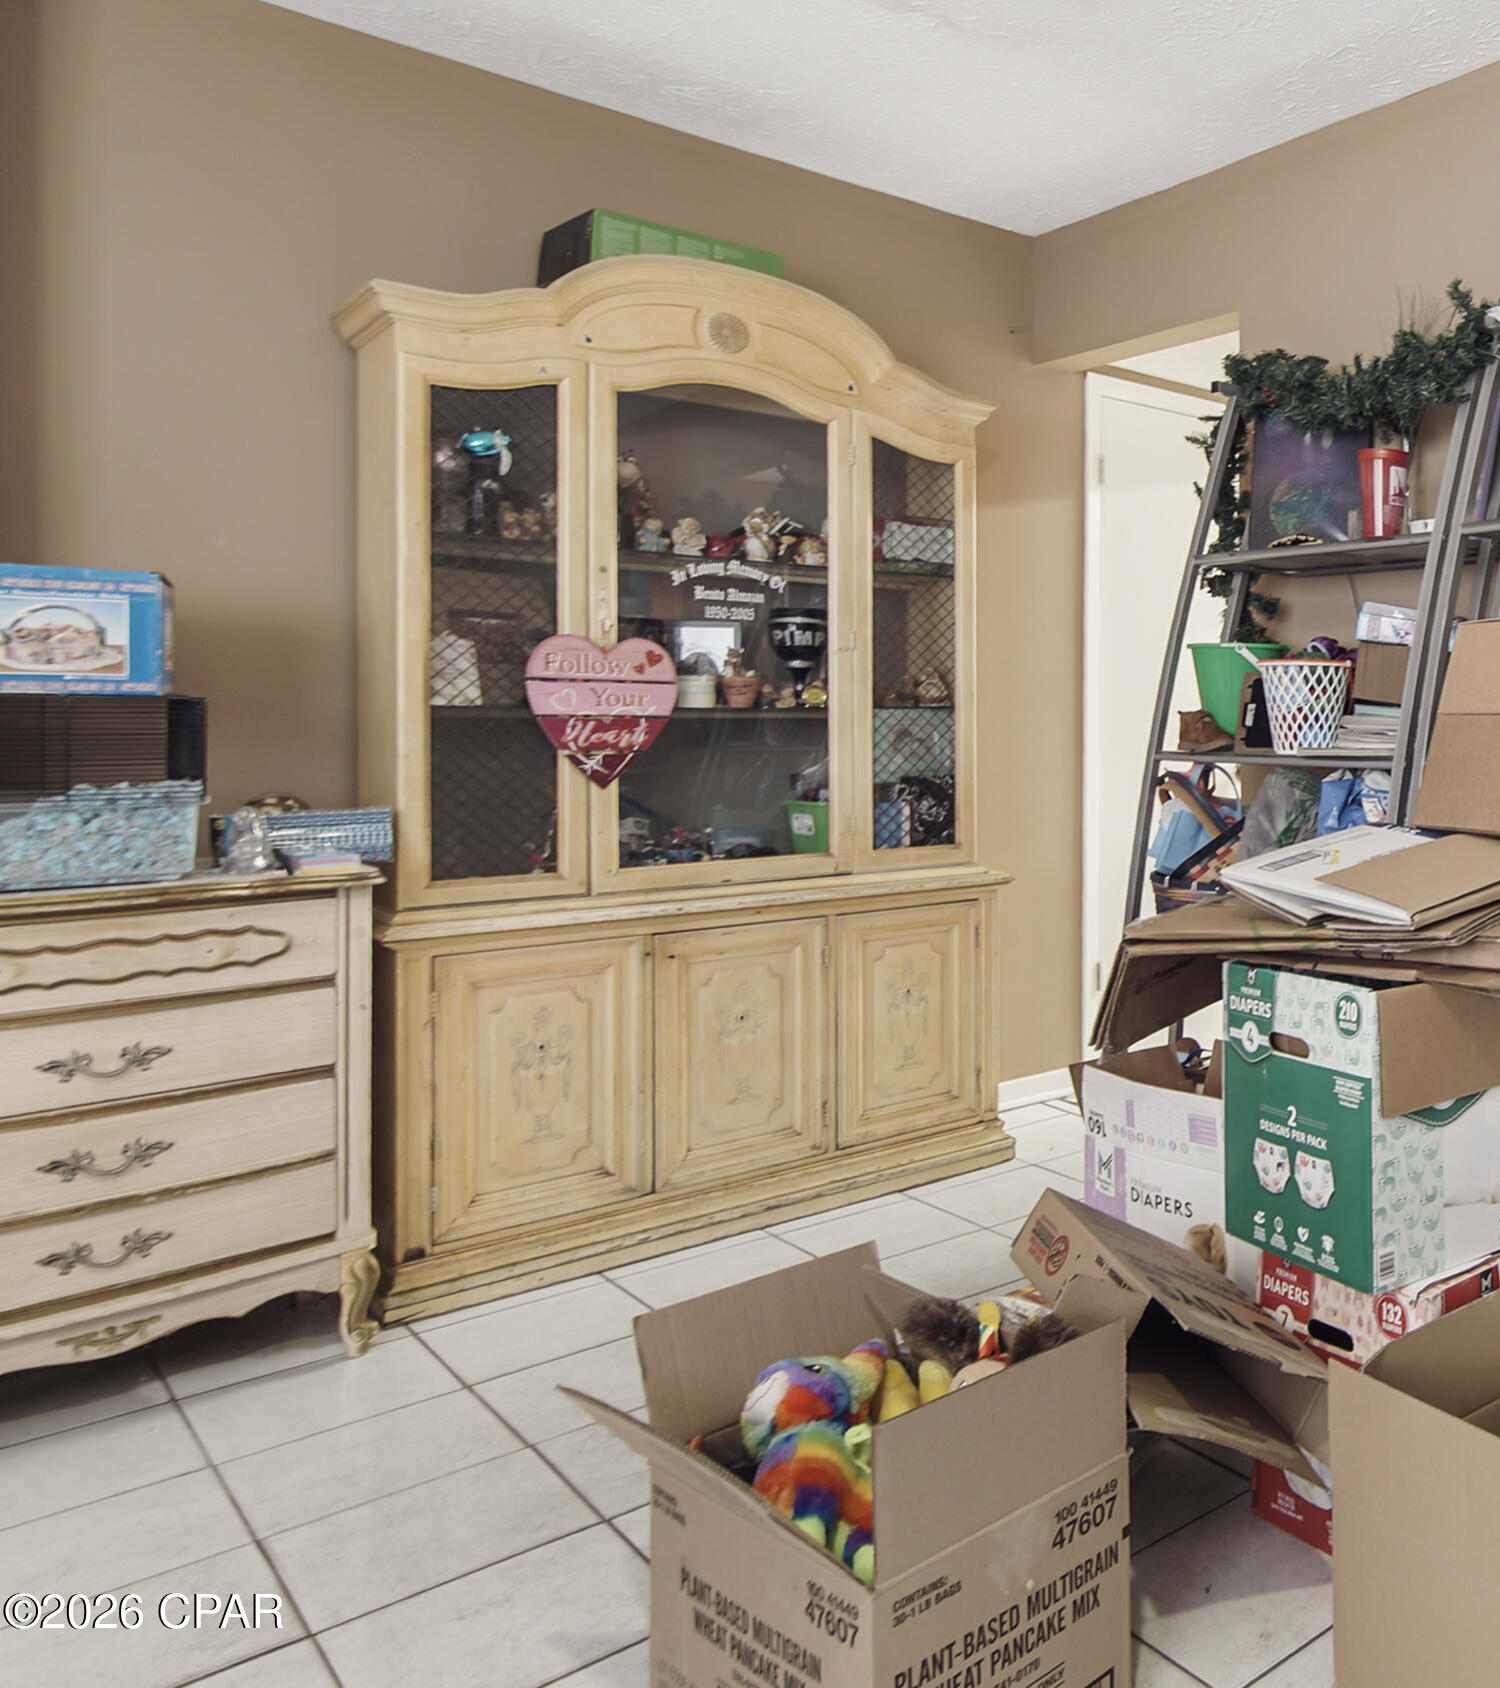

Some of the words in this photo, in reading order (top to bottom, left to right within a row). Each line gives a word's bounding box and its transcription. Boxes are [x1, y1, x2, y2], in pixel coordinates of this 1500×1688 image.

[669, 569, 687, 586] In
[686, 561, 725, 579] Loving
[726, 559, 769, 585] Memory
[542, 652, 632, 678] Follow
[589, 685, 649, 708] Your
[559, 717, 650, 749] Heart
[1229, 995, 1272, 1019] DIAPERS
[1339, 1000, 1359, 1022] 210
[1246, 1027, 1254, 1046] 4
[1287, 1105, 1297, 1127] 2
[1259, 1118, 1291, 1139] DESIGNS
[1291, 1129, 1306, 1144] PER
[1307, 1133, 1328, 1151] PACK
[1130, 1186, 1193, 1218] DIAPERS
[1263, 1274, 1310, 1307] DIAPERS
[1281, 1310, 1289, 1327] 7
[1381, 1301, 1402, 1325] 132
[1054, 1501, 1079, 1524] 100
[1080, 1478, 1118, 1513] 41449
[1051, 1494, 1118, 1550] 47607
[892, 1575, 949, 1614] CONTAINS:
[918, 1598, 932, 1616] LB
[934, 1580, 962, 1605] BAGS
[680, 1564, 750, 1636] PLANT-BASED
[752, 1616, 822, 1685] MULTIGRAIN
[804, 1598, 859, 1649] 47607
[893, 1604, 1021, 1688] PLANT-BASED
[1026, 1540, 1120, 1622] MULTIGRAIN
[934, 1657, 984, 1688] HEAT
[990, 1606, 1066, 1677] PANCAKE
[1071, 1583, 1101, 1624] MIX
[730, 1633, 780, 1688] PANCAKE
